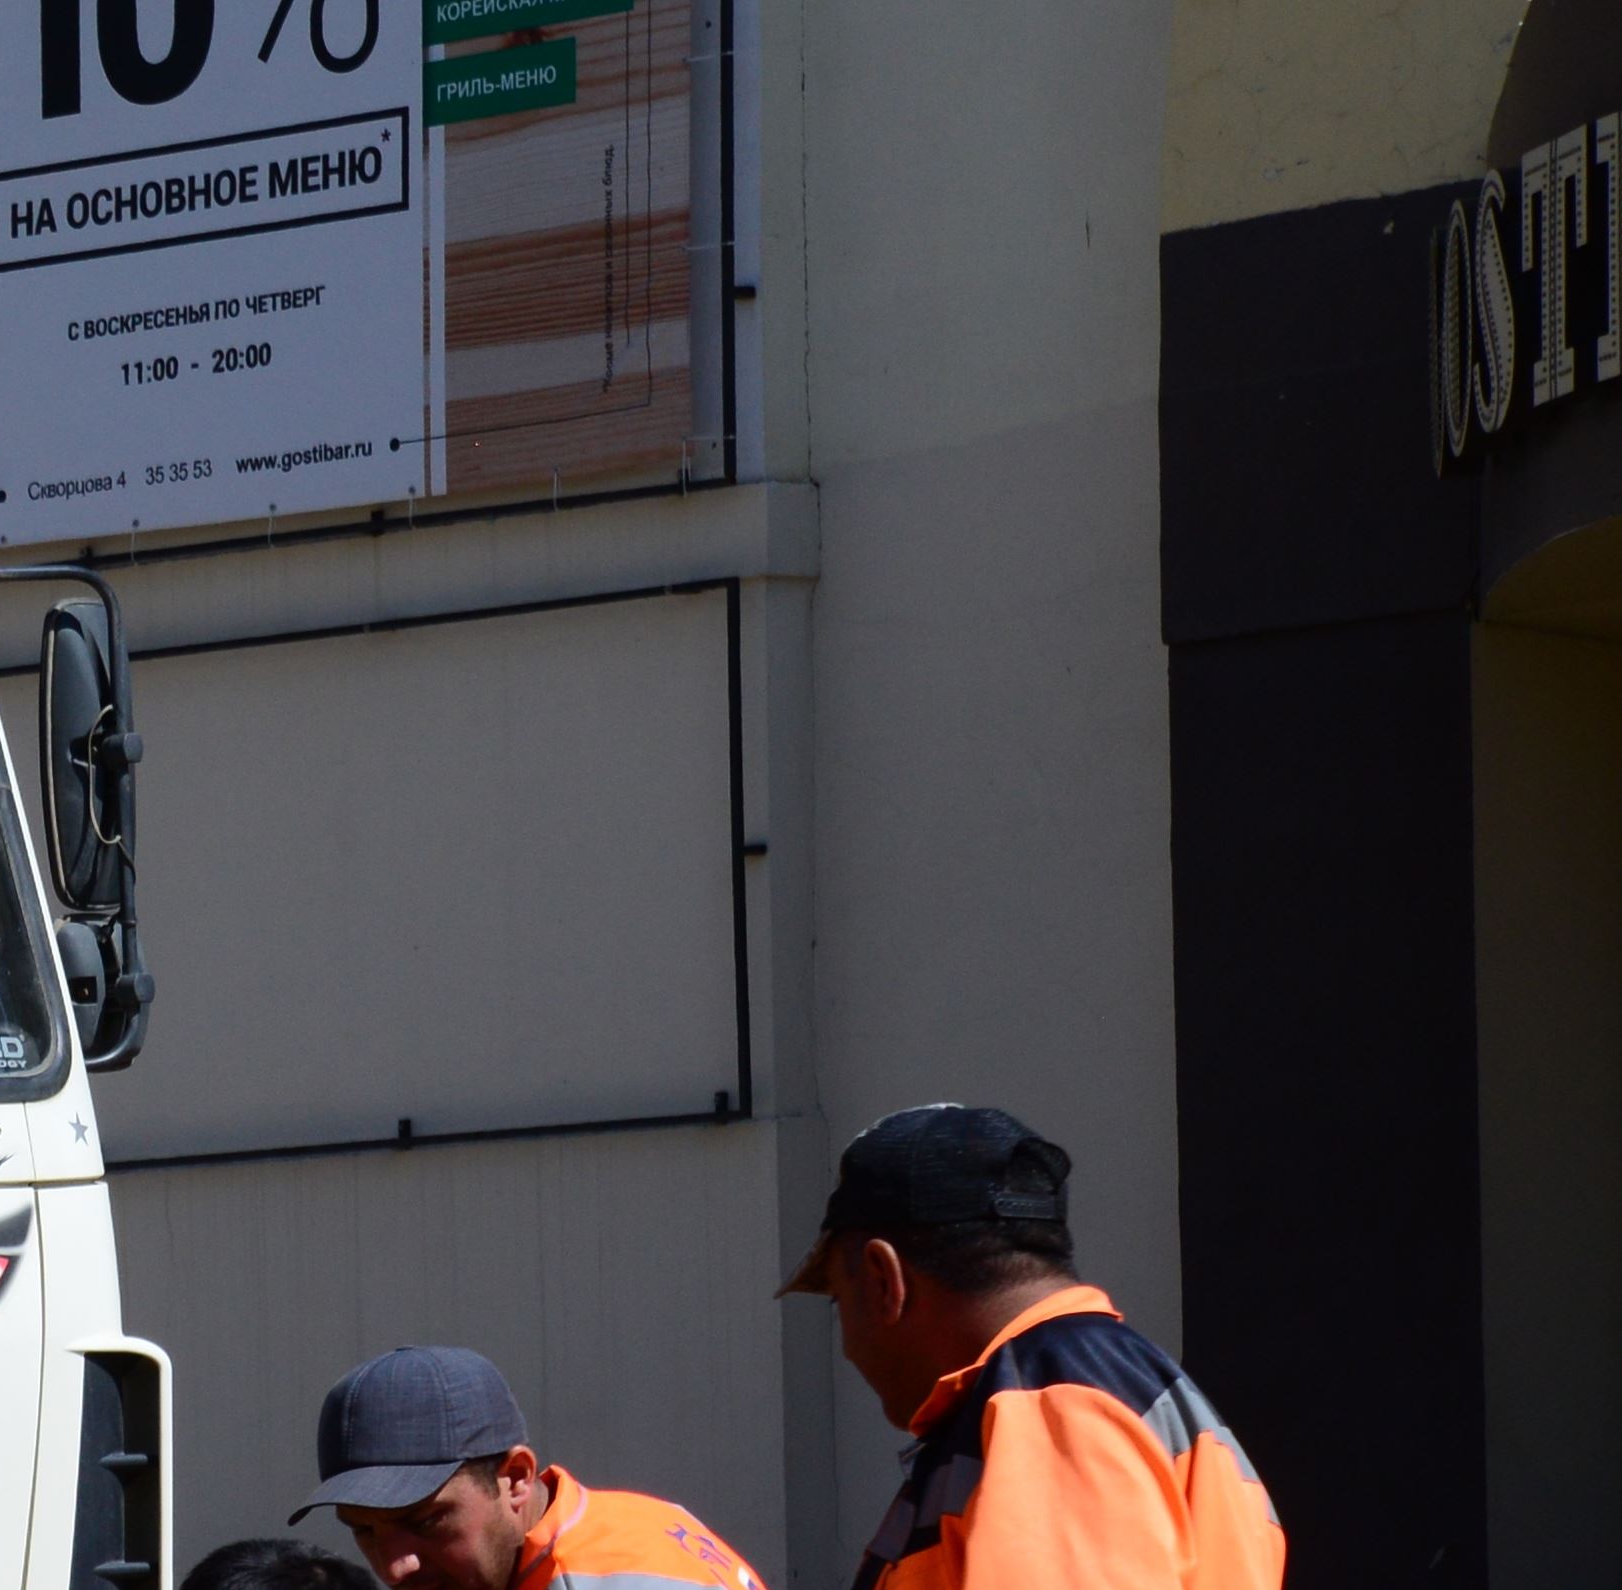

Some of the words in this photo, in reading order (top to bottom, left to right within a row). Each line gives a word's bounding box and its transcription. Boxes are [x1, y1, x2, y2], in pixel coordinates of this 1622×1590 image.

[436, 65, 557, 102] ГРИЛЬ-МЕНЮ
[10, 198, 57, 239] НА
[66, 166, 259, 230] ОСНОВНОЕ
[67, 323, 80, 342] С
[84, 301, 211, 339] ВОСКРЕСЕНЬЯ
[214, 299, 241, 321] ПО
[245, 285, 326, 315] ЧЕТВЕРГ
[121, 356, 180, 386] 11:00
[211, 342, 273, 373] 20:00
[145, 466, 165, 486] 35
[168, 462, 189, 482] 35
[192, 459, 213, 480] 53
[235, 440, 374, 475] www.gostibar.ru
[27, 474, 113, 502] Скворцова
[116, 471, 128, 489] 4
